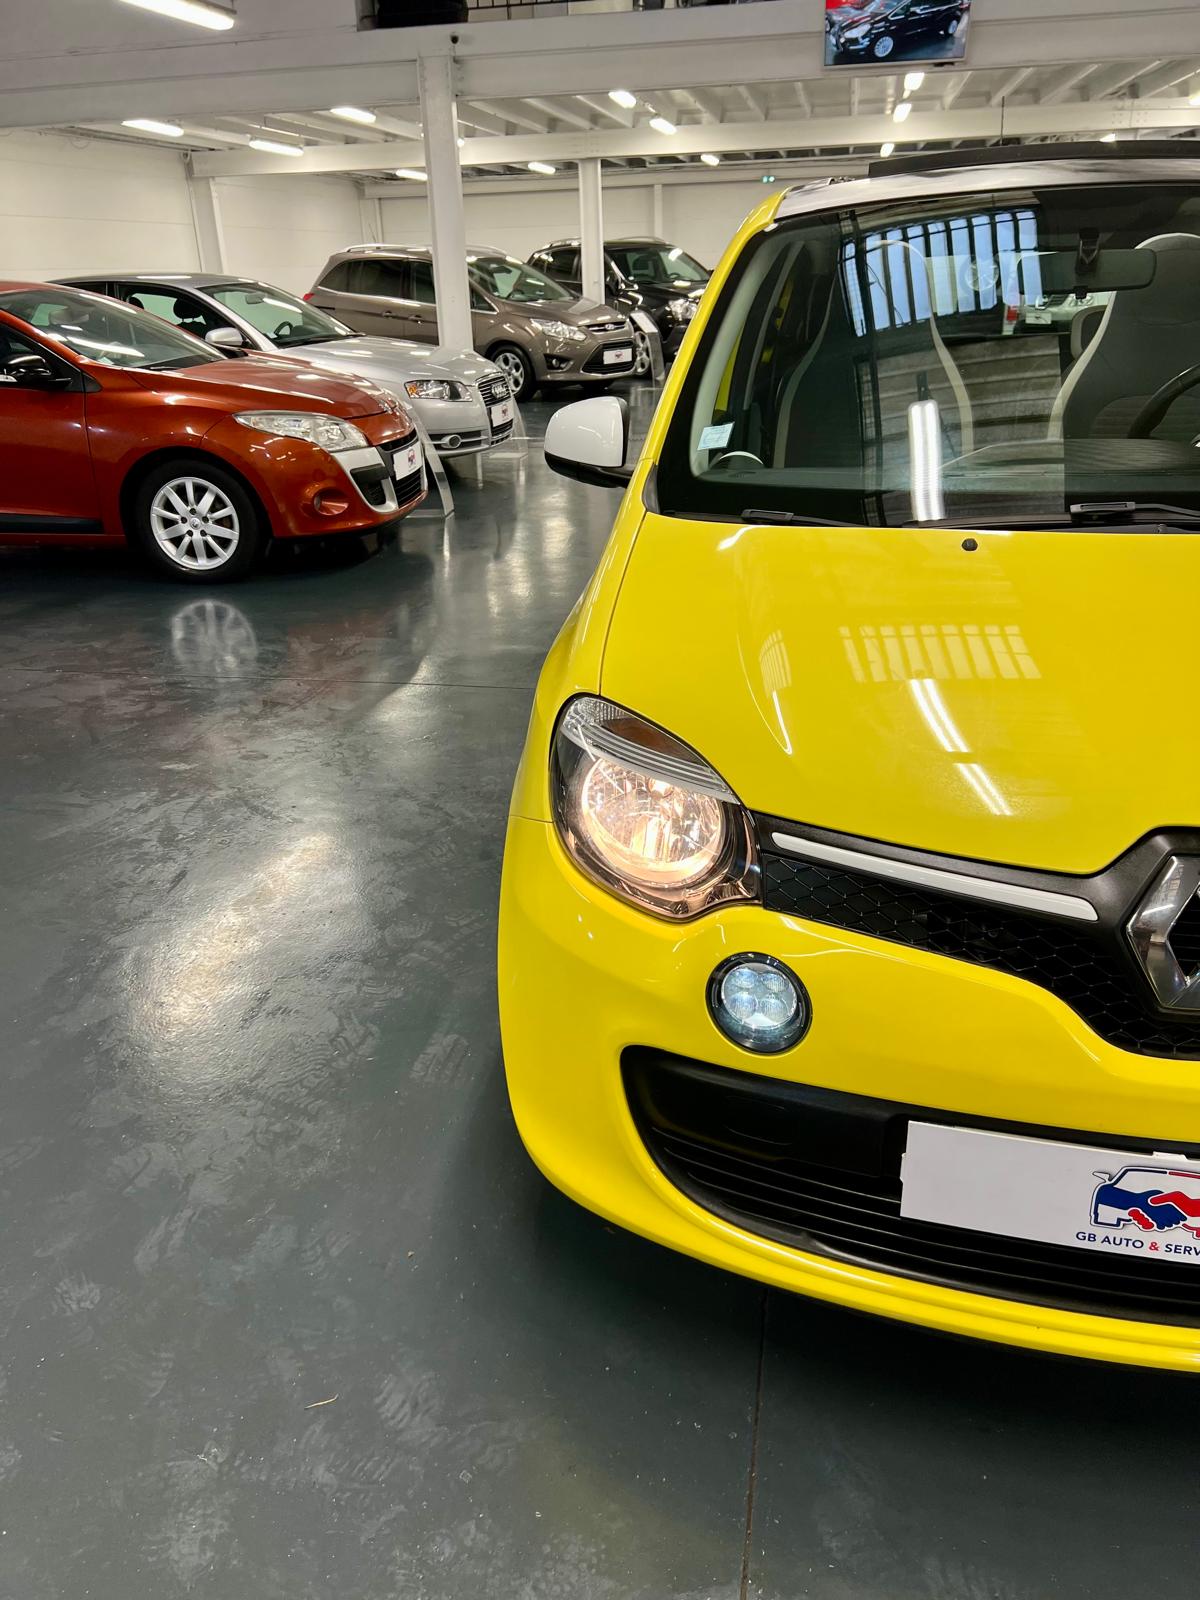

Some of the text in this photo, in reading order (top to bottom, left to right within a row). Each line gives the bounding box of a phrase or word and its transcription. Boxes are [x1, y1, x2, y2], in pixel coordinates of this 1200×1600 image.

[1075, 1231, 1097, 1242] GB
[1101, 1235, 1144, 1249] AUTO
[1149, 1241, 1160, 1252] &
